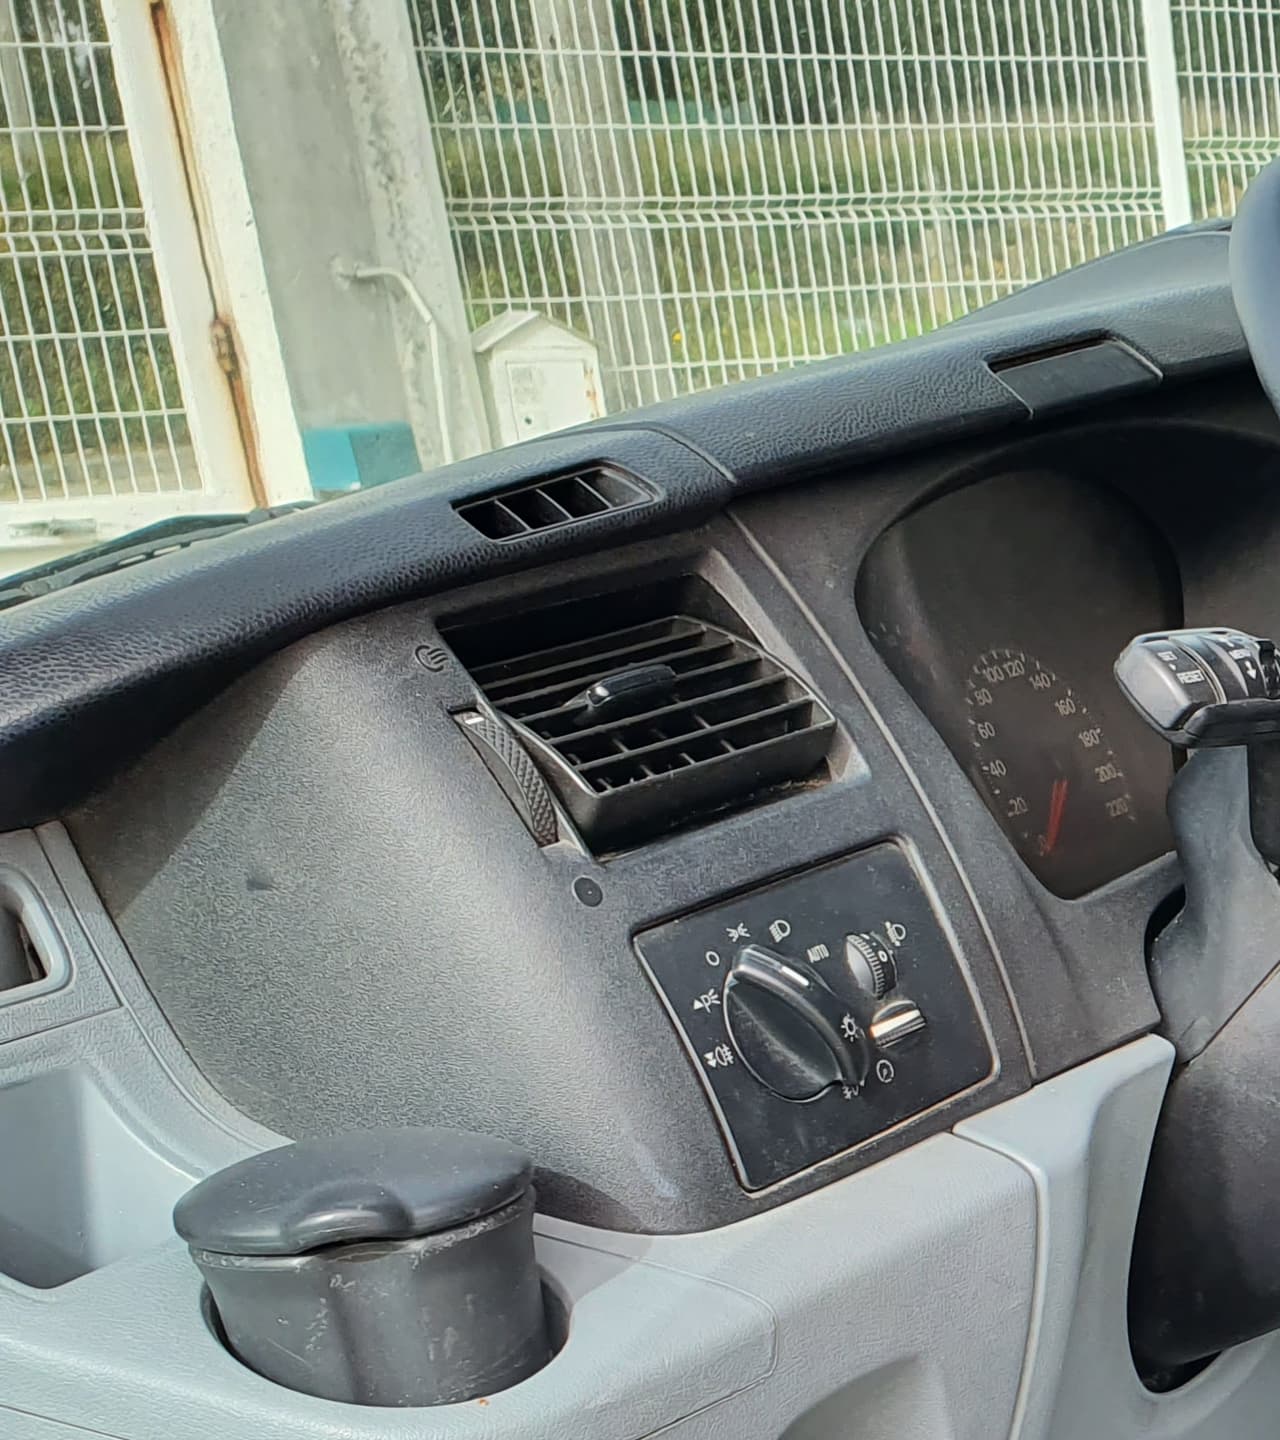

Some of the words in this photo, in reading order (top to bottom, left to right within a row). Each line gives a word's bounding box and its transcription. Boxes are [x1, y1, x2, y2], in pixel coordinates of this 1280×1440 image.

[982, 665, 1005, 682] 100
[1002, 659, 1025, 678] 120
[1029, 672, 1051, 690] 140
[974, 688, 993, 706] 80
[1054, 697, 1076, 716] 160
[977, 721, 996, 739] 60
[1078, 729, 1100, 748] 180
[990, 759, 1007, 777] 40
